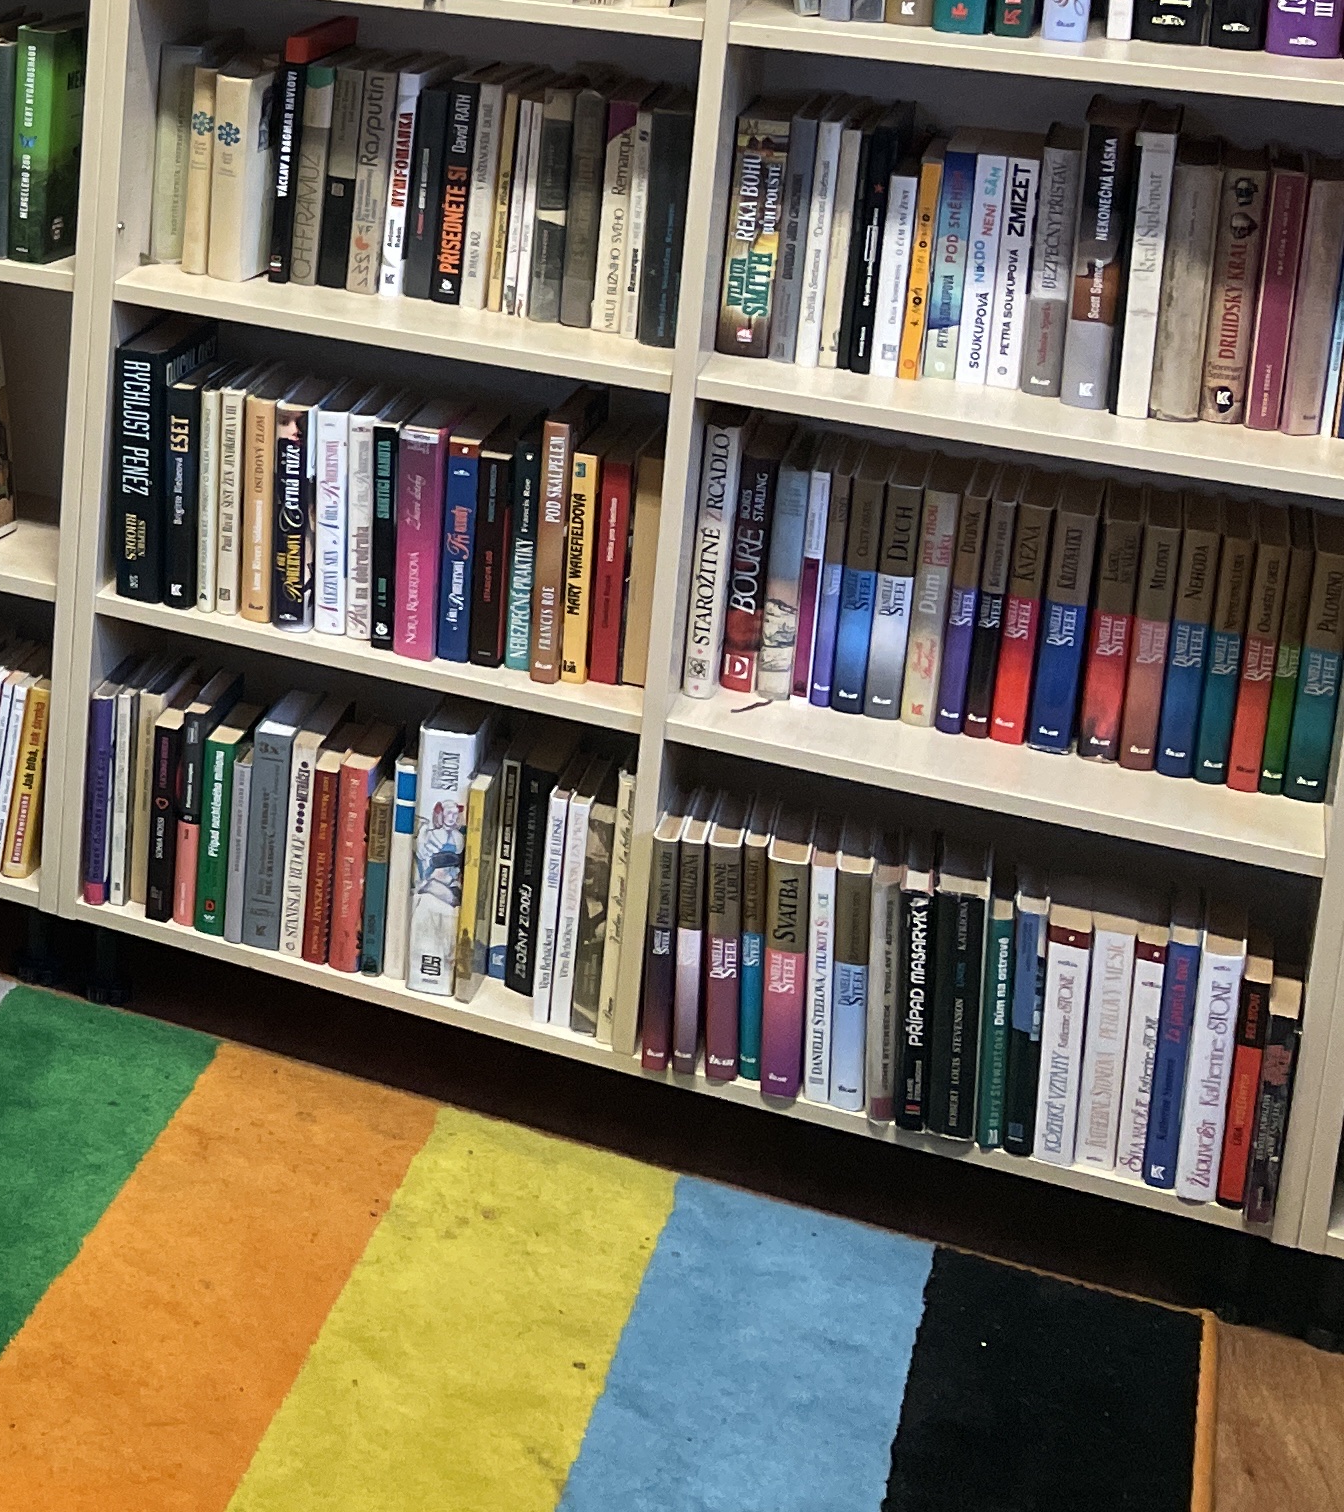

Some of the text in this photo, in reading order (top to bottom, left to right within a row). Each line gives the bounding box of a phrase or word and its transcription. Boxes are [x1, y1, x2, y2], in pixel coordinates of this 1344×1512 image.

[360, 75, 385, 167] Rasputin
[392, 113, 413, 208] NYMFOMANKA
[452, 94, 472, 154] David RATH
[438, 166, 468, 274] PŘISEDNĚTE SI
[1007, 163, 1031, 238] ZMIZET
[122, 361, 151, 499] RYCHLOST PENĚZ
[171, 417, 191, 452] ESET
[696, 432, 731, 647] STAROŽITNÉ ZRCADLO
[731, 530, 764, 614] BOUŘE
[886, 507, 913, 561] DUCH
[443, 752, 460, 791] SARUM
[772, 878, 799, 944] SVATBA
